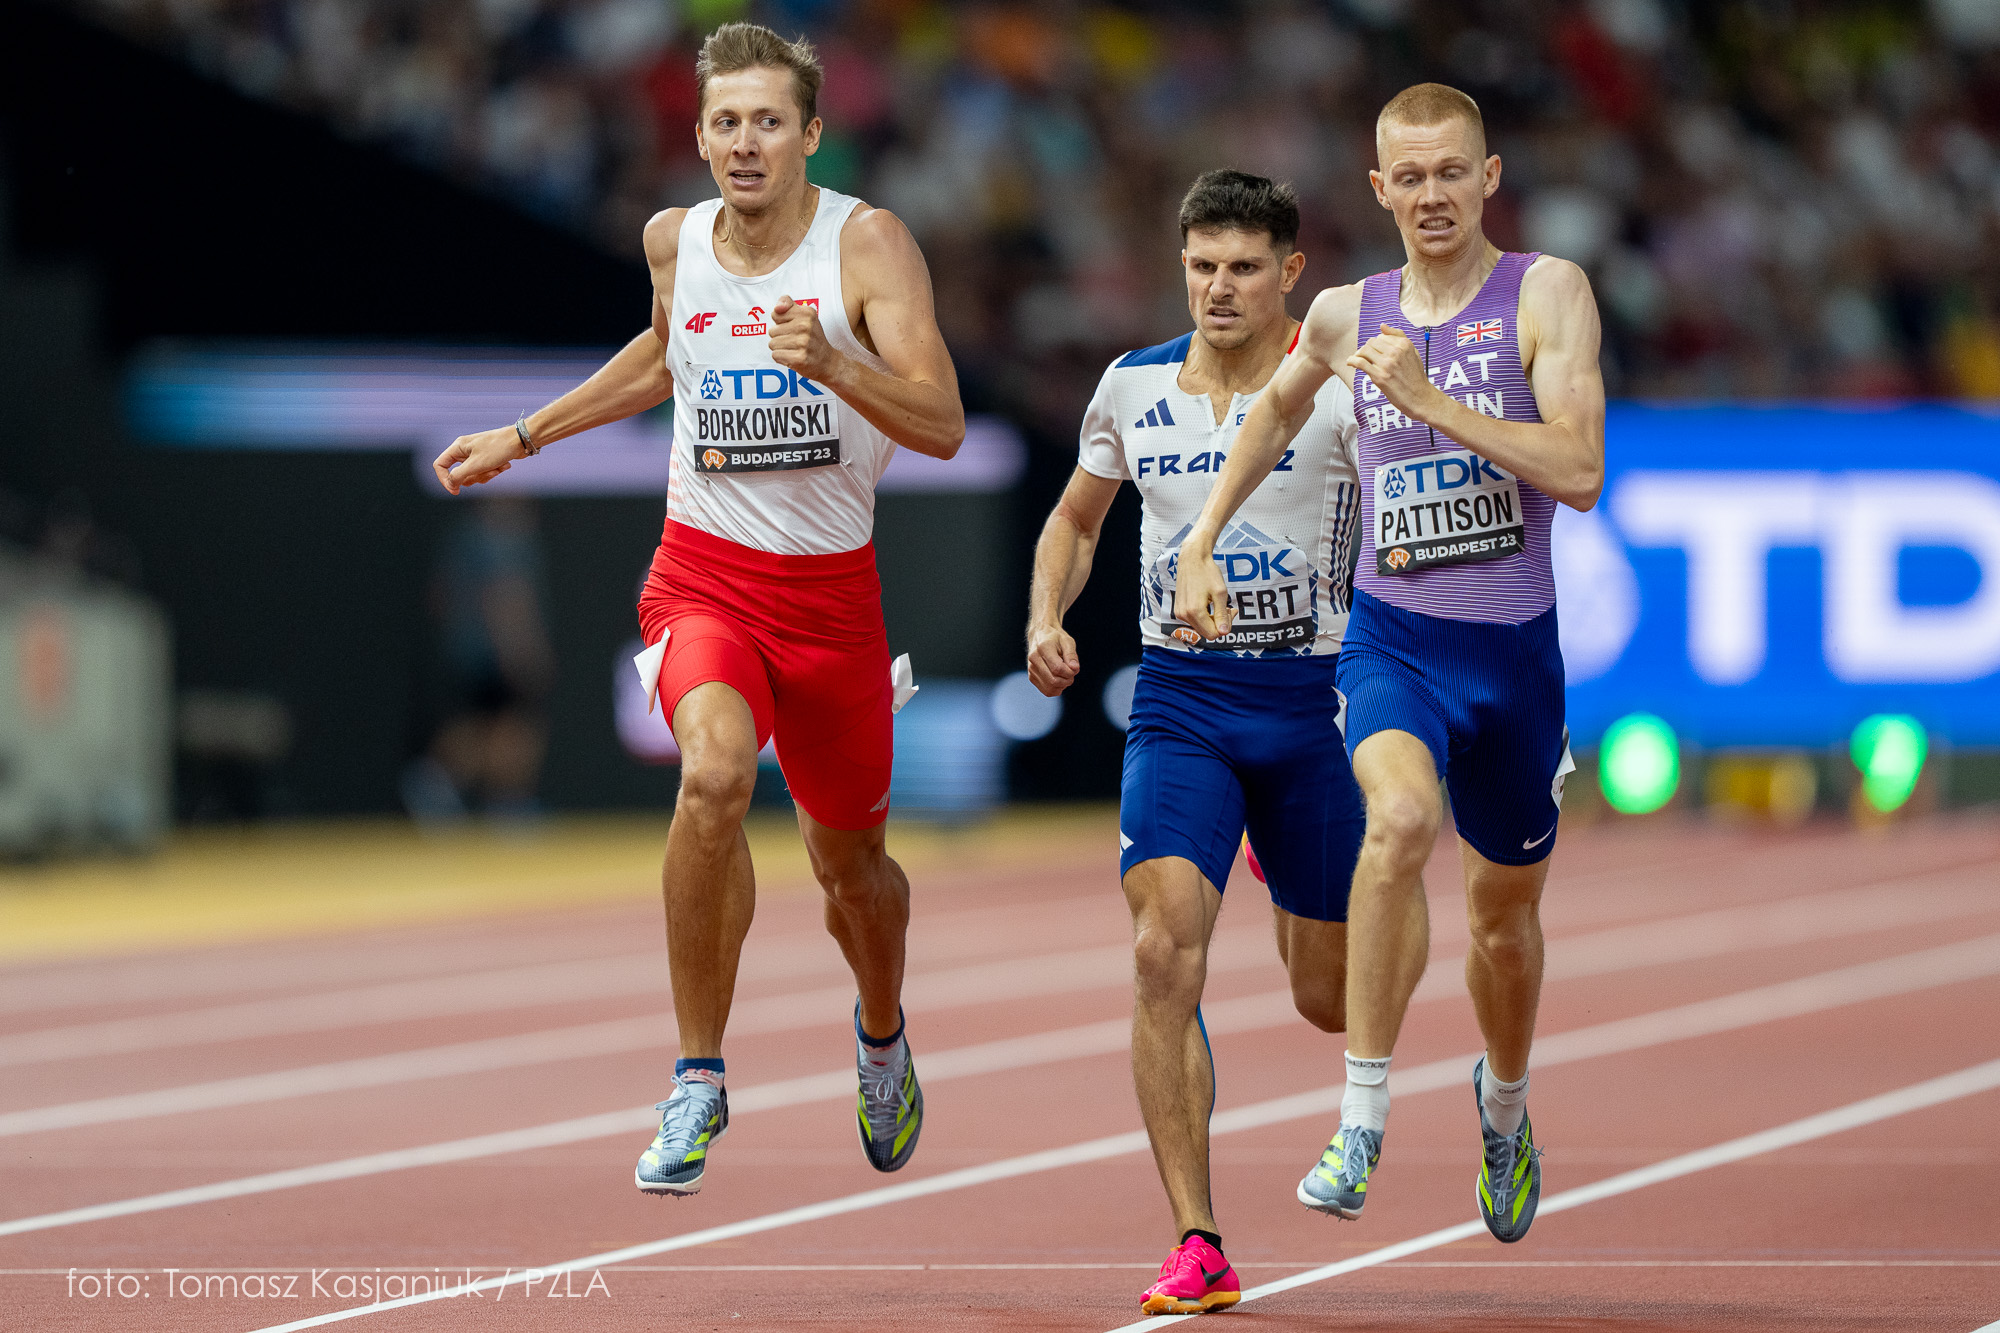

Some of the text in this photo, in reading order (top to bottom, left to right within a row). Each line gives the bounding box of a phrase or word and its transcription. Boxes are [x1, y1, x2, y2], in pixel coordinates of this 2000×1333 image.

[685, 312, 718, 333] 4F
[733, 325, 765, 335] ORLEN
[722, 368, 825, 400] TDK
[697, 403, 831, 441] BORKOWSKI
[731, 447, 831, 465] BUDAPEST 23
[1405, 455, 1506, 493] TDK
[1382, 491, 1514, 543] PATTISON
[1415, 534, 1517, 561] BUDAPEST 23
[1286, 626, 1304, 639] 23
